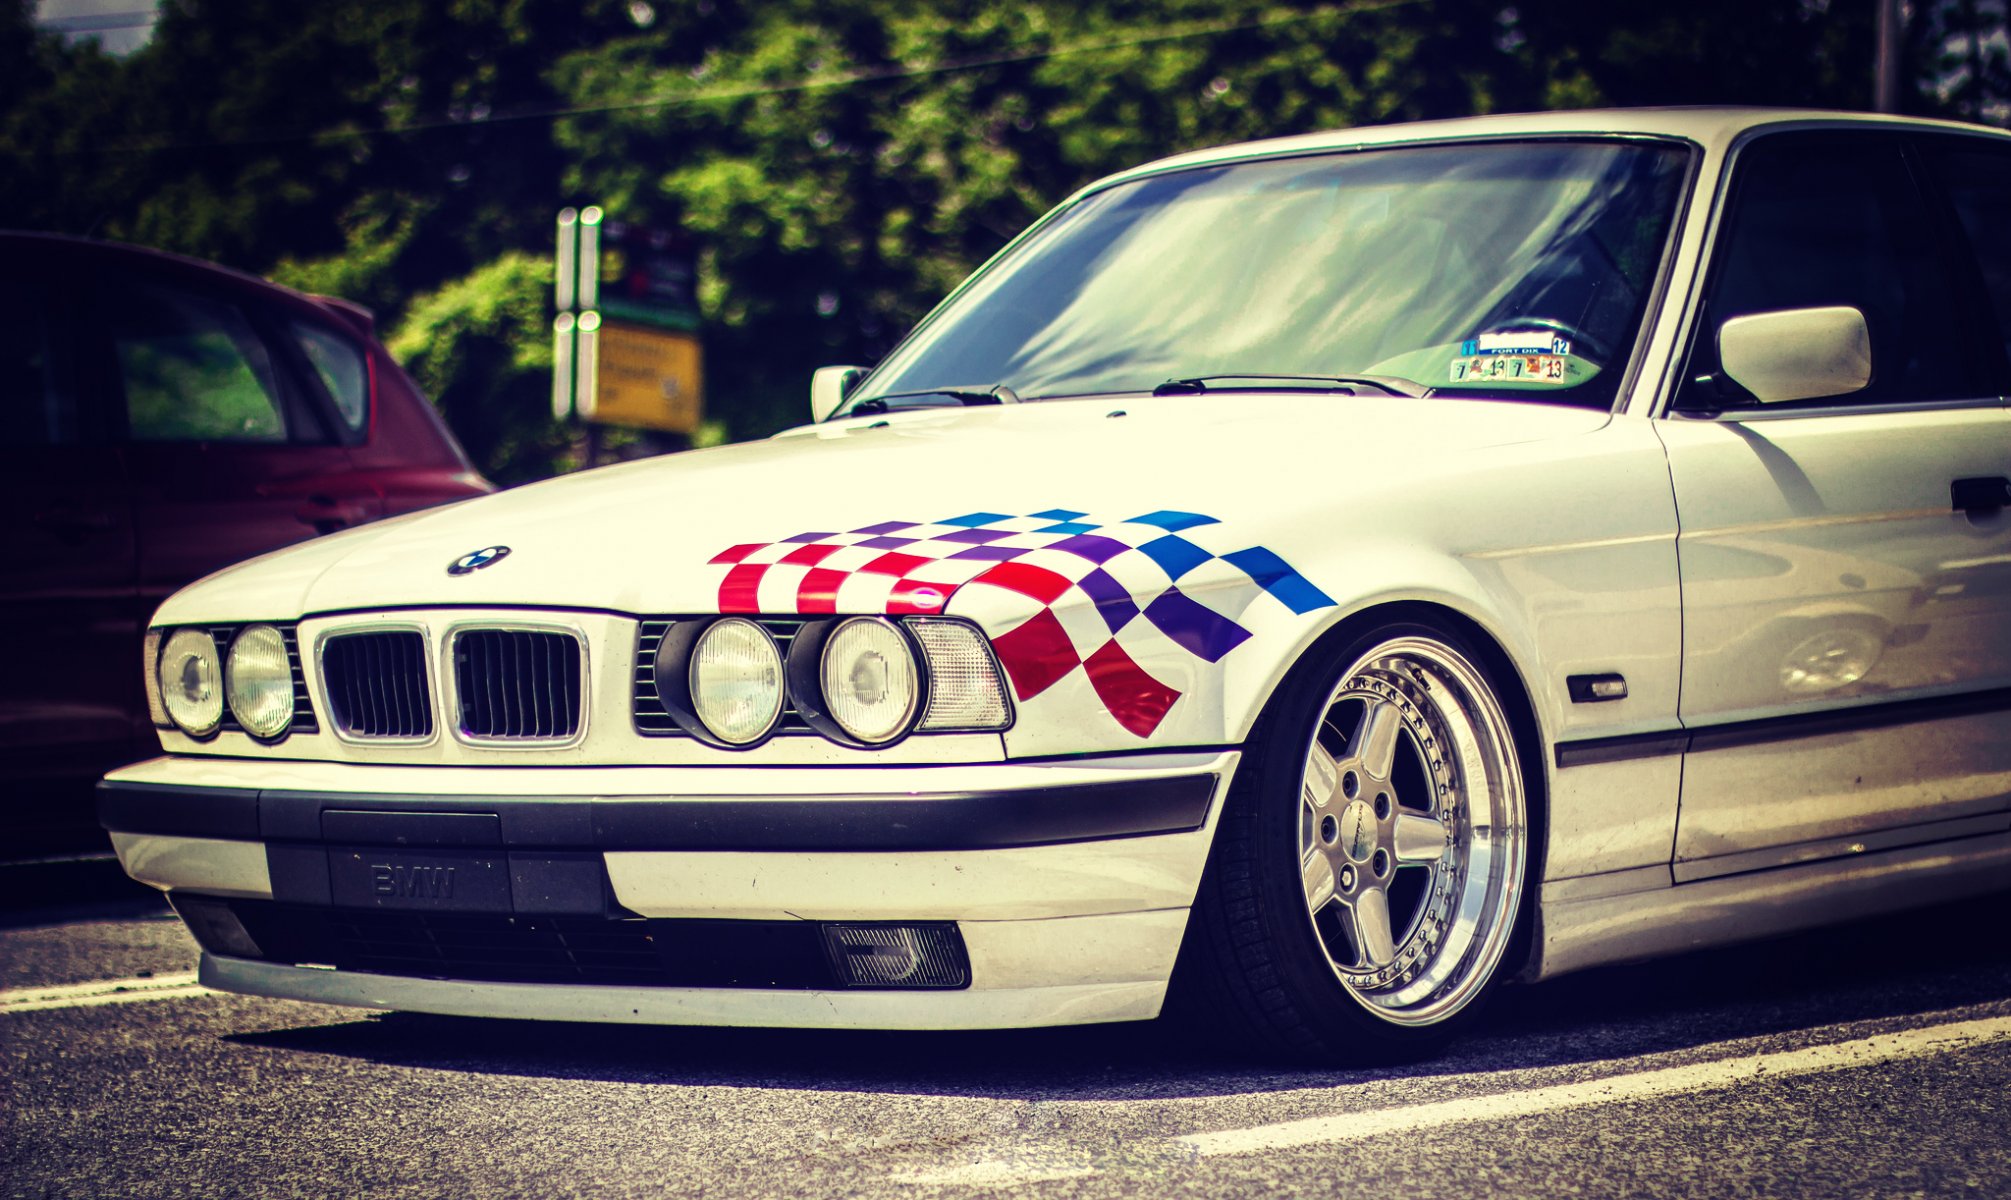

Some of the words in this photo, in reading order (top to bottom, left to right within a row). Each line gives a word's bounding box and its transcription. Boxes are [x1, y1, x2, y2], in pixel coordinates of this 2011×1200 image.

[1553, 339, 1567, 354] 12
[1457, 363, 1466, 379] 7
[1513, 362, 1522, 377] 7
[1546, 360, 1562, 378] 13
[371, 865, 455, 899] BMW
